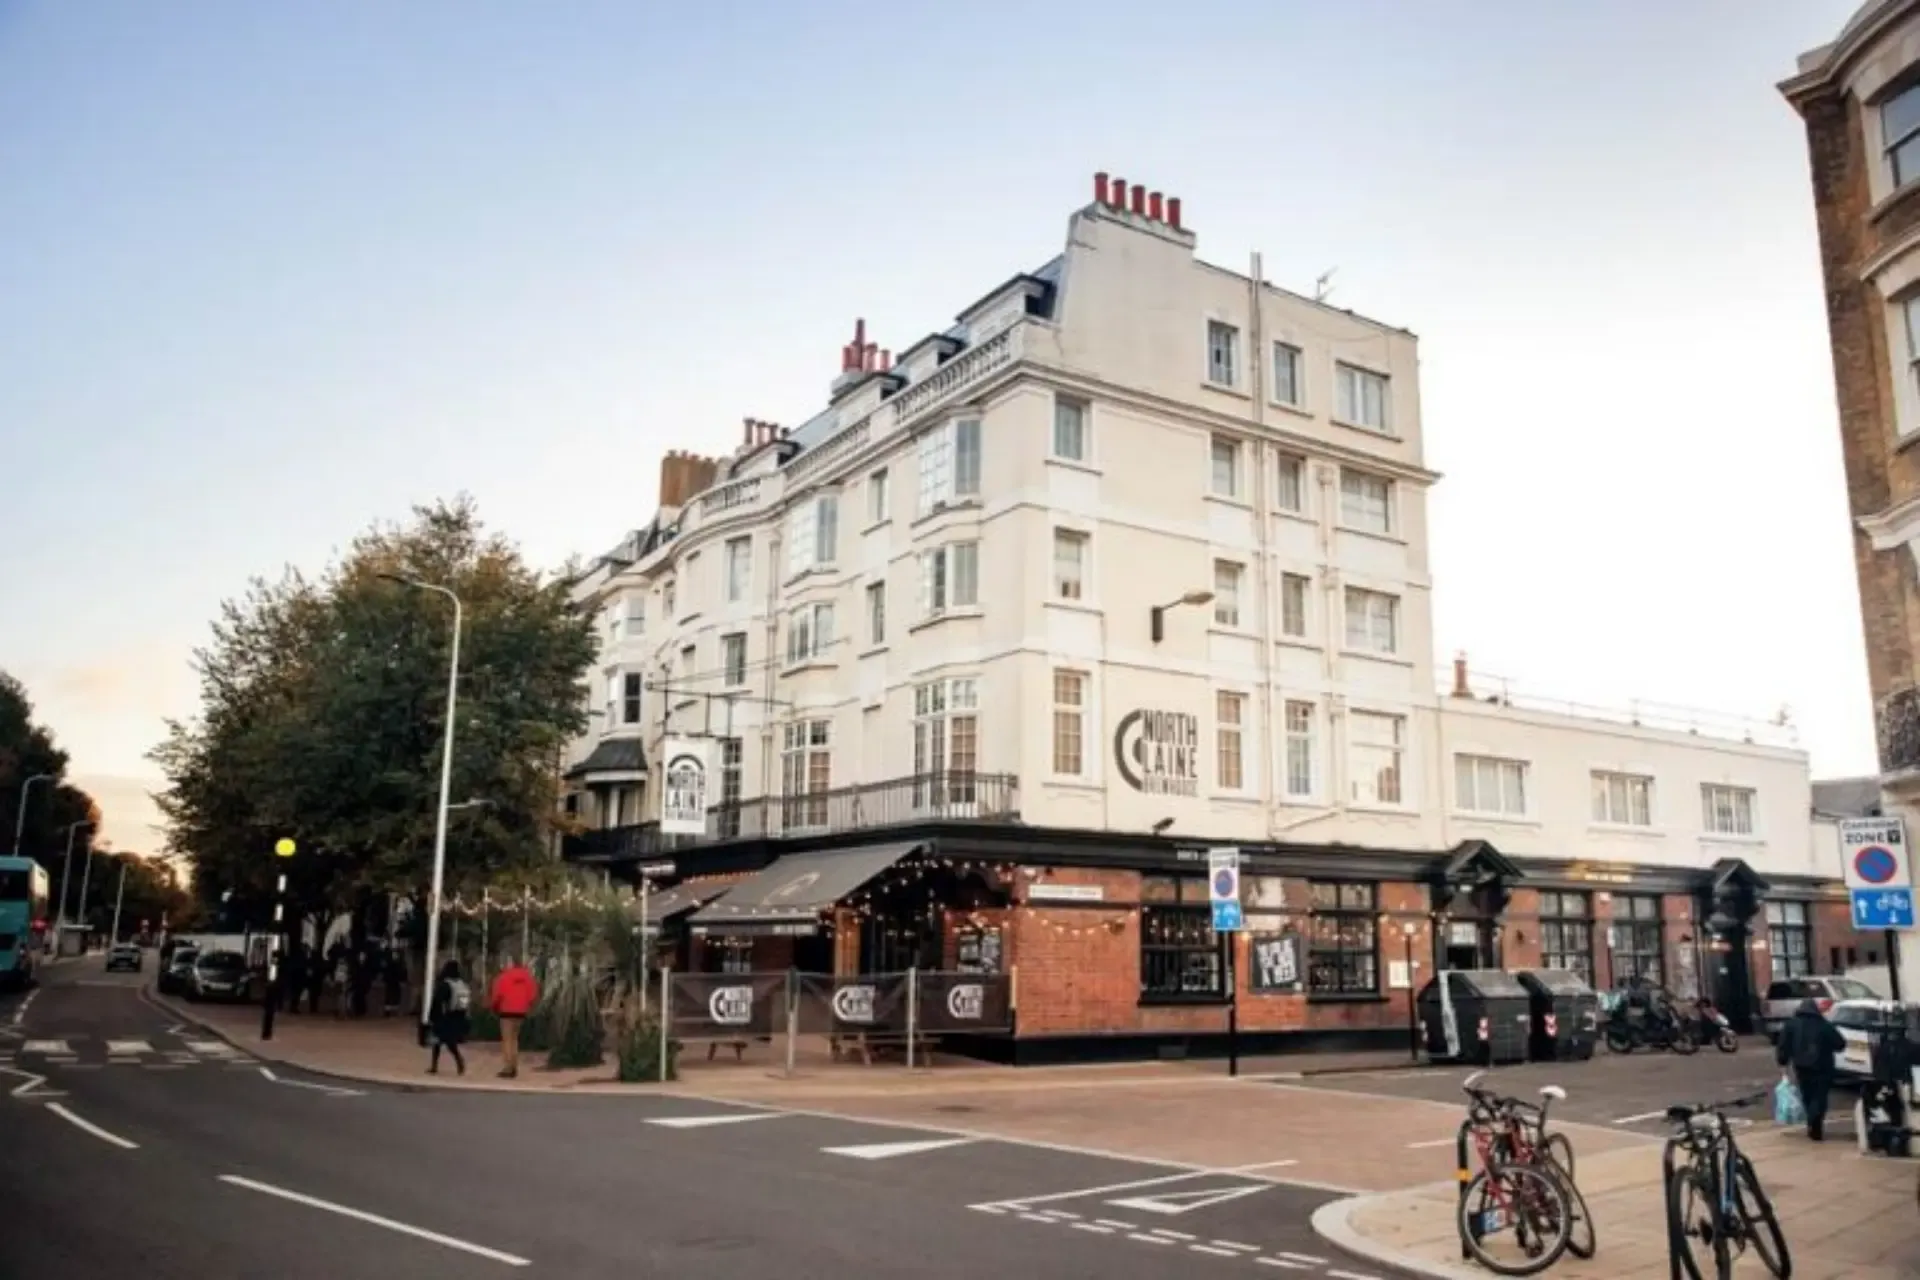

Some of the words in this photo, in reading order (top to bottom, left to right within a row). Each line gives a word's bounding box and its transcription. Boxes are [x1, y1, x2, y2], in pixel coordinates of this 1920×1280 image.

[1143, 709, 1198, 746] NORTH
[1142, 742, 1198, 778] LAINE
[1846, 831, 1885, 844] ZONE
